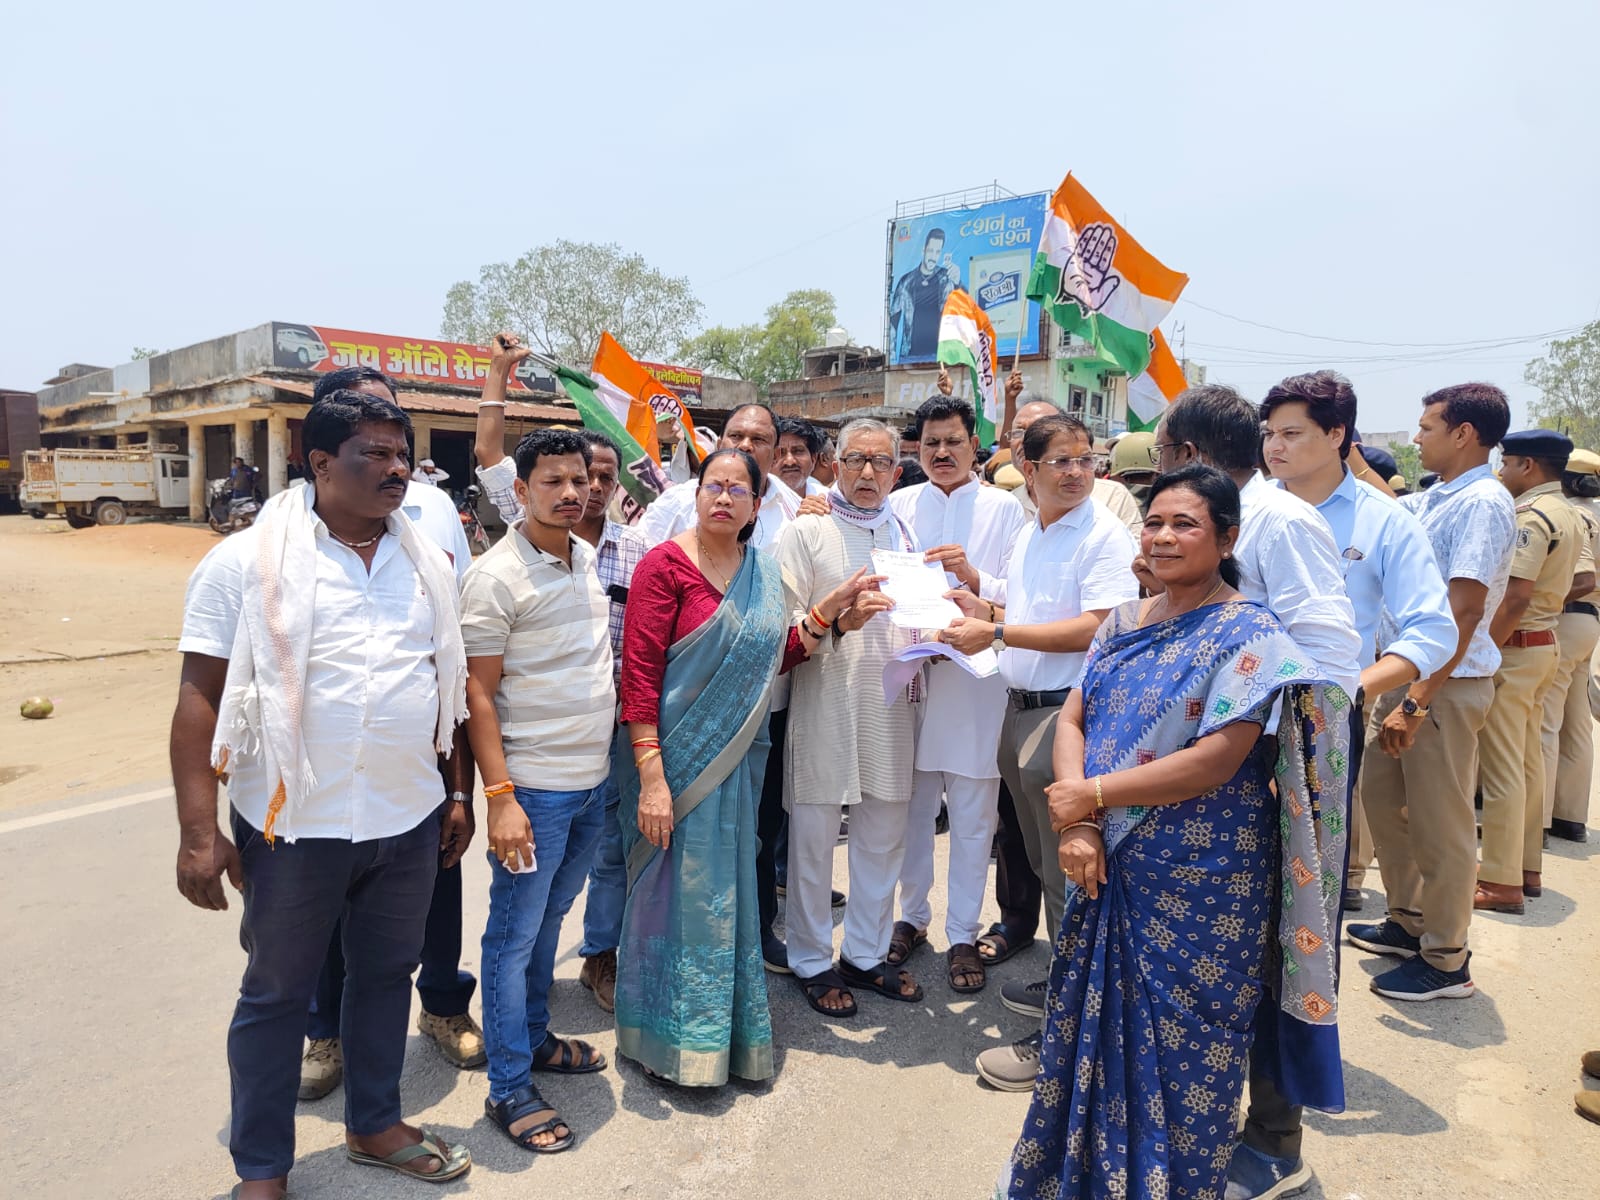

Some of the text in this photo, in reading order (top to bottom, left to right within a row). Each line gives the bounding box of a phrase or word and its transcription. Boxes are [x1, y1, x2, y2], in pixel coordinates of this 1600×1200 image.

[960, 213, 1025, 237] टशन का
[989, 228, 1032, 247] जश्न
[330, 341, 381, 371] जय
[386, 343, 449, 378] ऑटो
